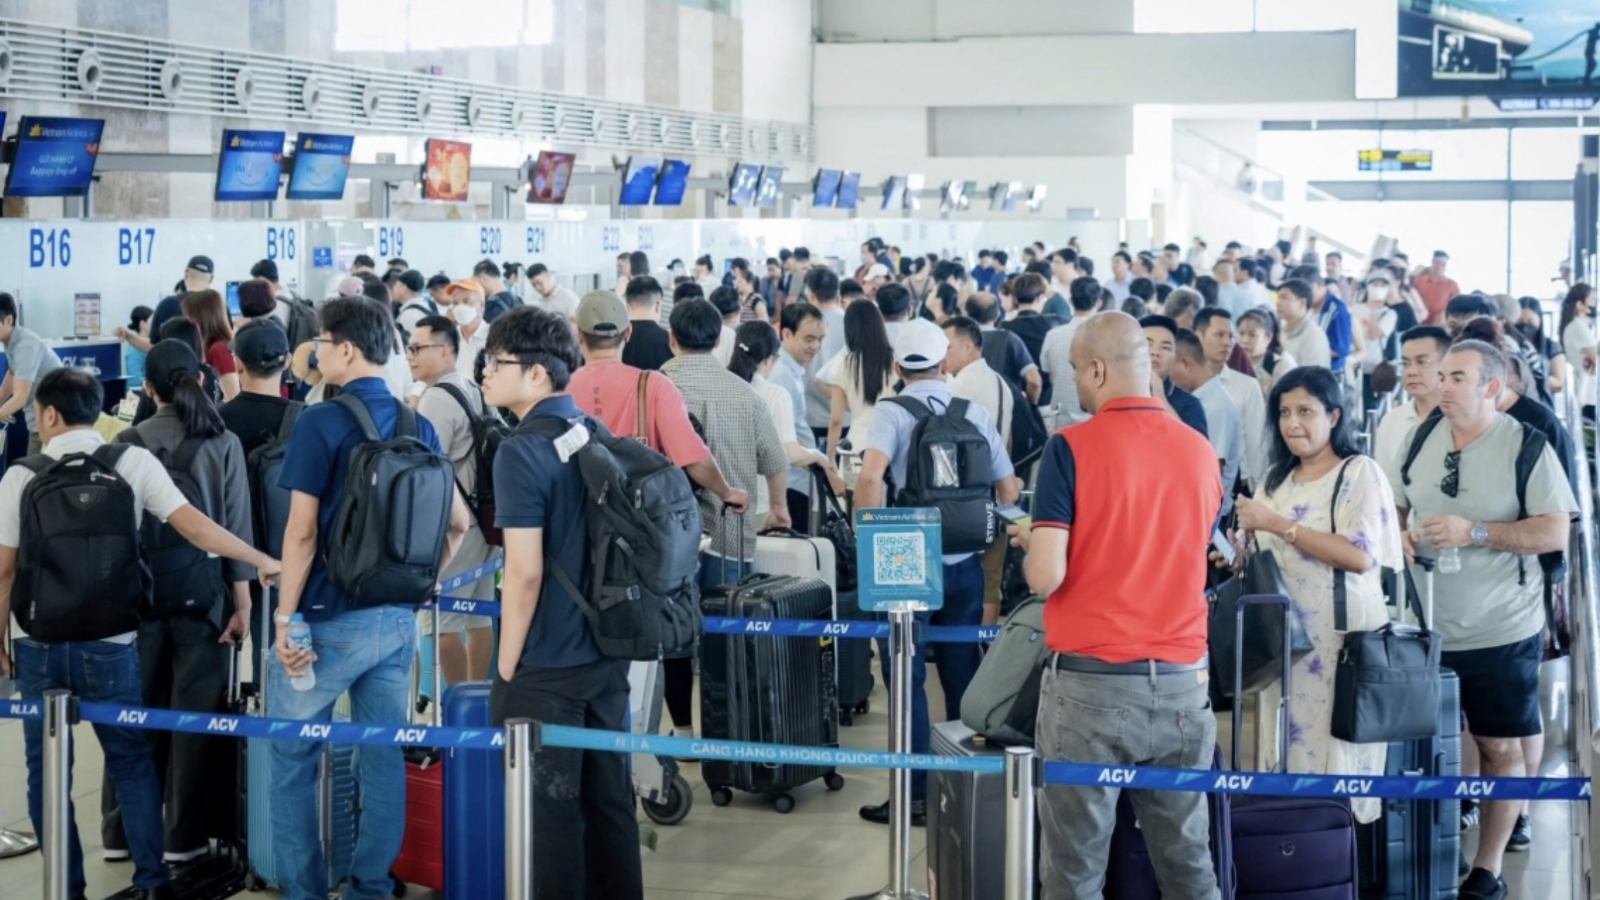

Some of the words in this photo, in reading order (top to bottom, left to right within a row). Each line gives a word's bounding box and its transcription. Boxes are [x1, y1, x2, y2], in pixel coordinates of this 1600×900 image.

[29, 228, 72, 268] B16
[118, 228, 156, 265] B17
[267, 227, 296, 260] B18
[379, 227, 404, 256] B19
[481, 227, 501, 254] B20
[527, 226, 545, 253] B21
[985, 502, 994, 544] STRIVE
[452, 601, 476, 612] ACV
[746, 621, 772, 632] ACV
[823, 623, 849, 634] ACV
[10, 704, 39, 715] N.I.A
[117, 710, 147, 724] ACV
[207, 718, 239, 732] ACV
[299, 724, 332, 738] ACV
[394, 729, 427, 743] ACV
[1097, 768, 1137, 783] ACV
[1213, 775, 1253, 790] ACV
[1333, 779, 1373, 793] ACV
[1455, 781, 1495, 795] ACV
